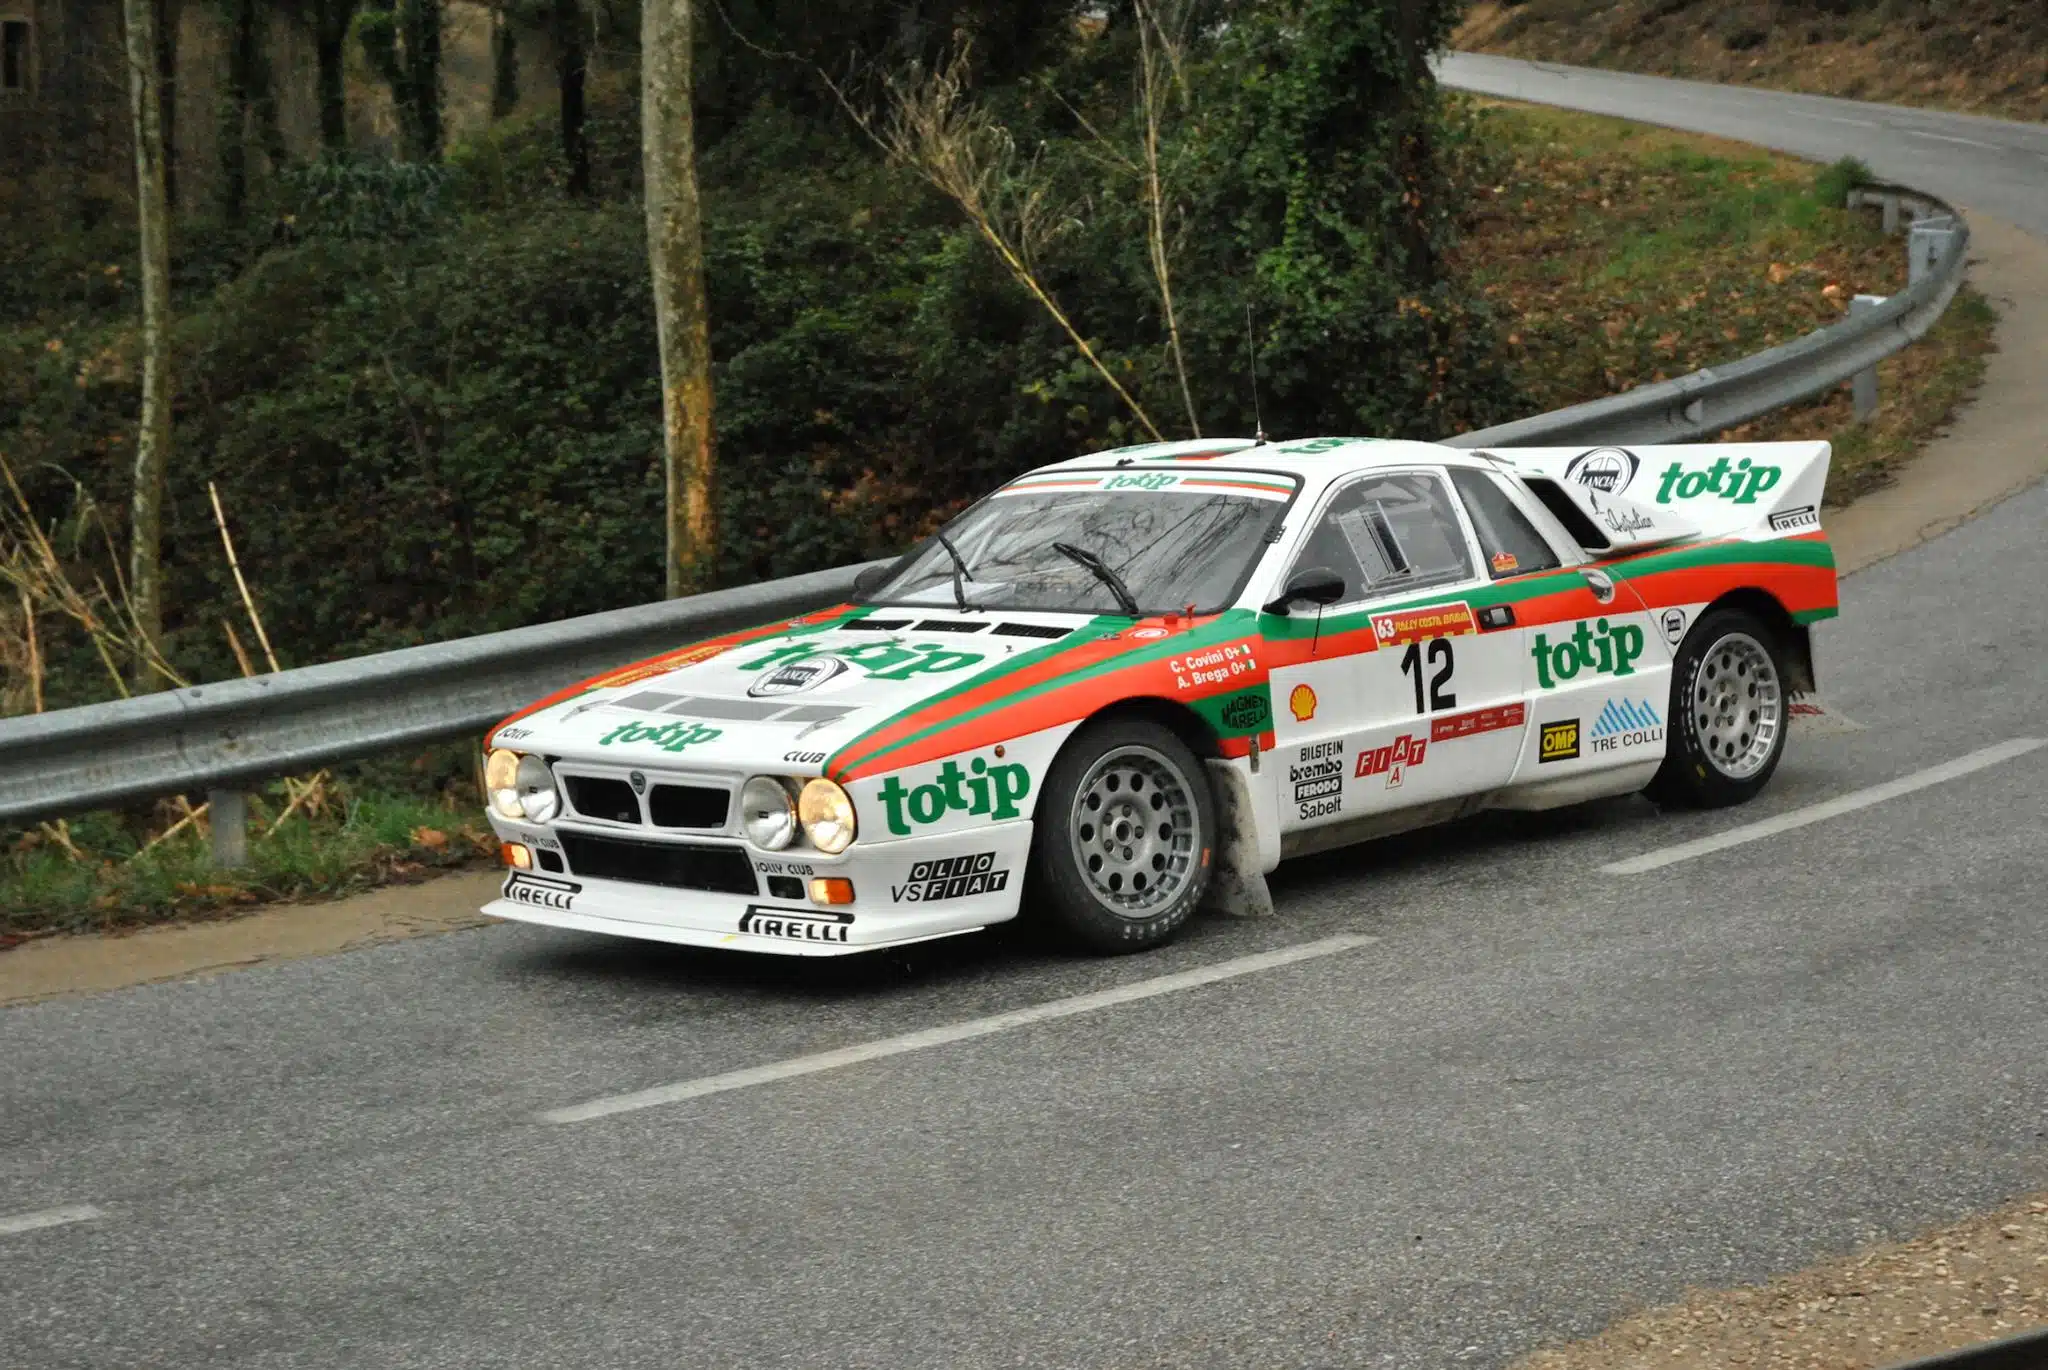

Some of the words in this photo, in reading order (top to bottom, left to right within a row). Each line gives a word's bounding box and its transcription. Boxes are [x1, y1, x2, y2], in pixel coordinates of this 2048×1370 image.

[1104, 472, 1179, 490] totip
[1580, 476, 1616, 489] LANCIA
[1656, 457, 1782, 504] totip
[1768, 505, 1818, 531] PIRELLI
[1377, 618, 1395, 638] 63
[1169, 660, 1186, 673] C.
[1186, 649, 1224, 669] Covini
[1531, 617, 1644, 689] totip
[1177, 675, 1191, 689] A.
[1191, 667, 1229, 686] Brega
[1400, 638, 1456, 714] 12
[599, 721, 723, 752] totip
[1543, 729, 1577, 752] OMP
[1591, 737, 1618, 753] TRE
[1623, 728, 1663, 747] COLLI
[783, 750, 826, 764] CLUB
[1300, 740, 1343, 762] BILSTEIN
[1357, 738, 1425, 776] FIAT
[1290, 758, 1343, 782] brembo
[877, 757, 1030, 835] totip
[1297, 779, 1340, 799] FERODO
[1300, 797, 1342, 820] Sabelt
[755, 862, 782, 874] JOLLY
[787, 864, 814, 876] CLUB
[911, 854, 993, 880] OLIO
[504, 870, 582, 910] PIRELLI
[891, 884, 921, 903] VS
[926, 872, 1006, 900] FIAT
[738, 904, 855, 942] PIRELLI
